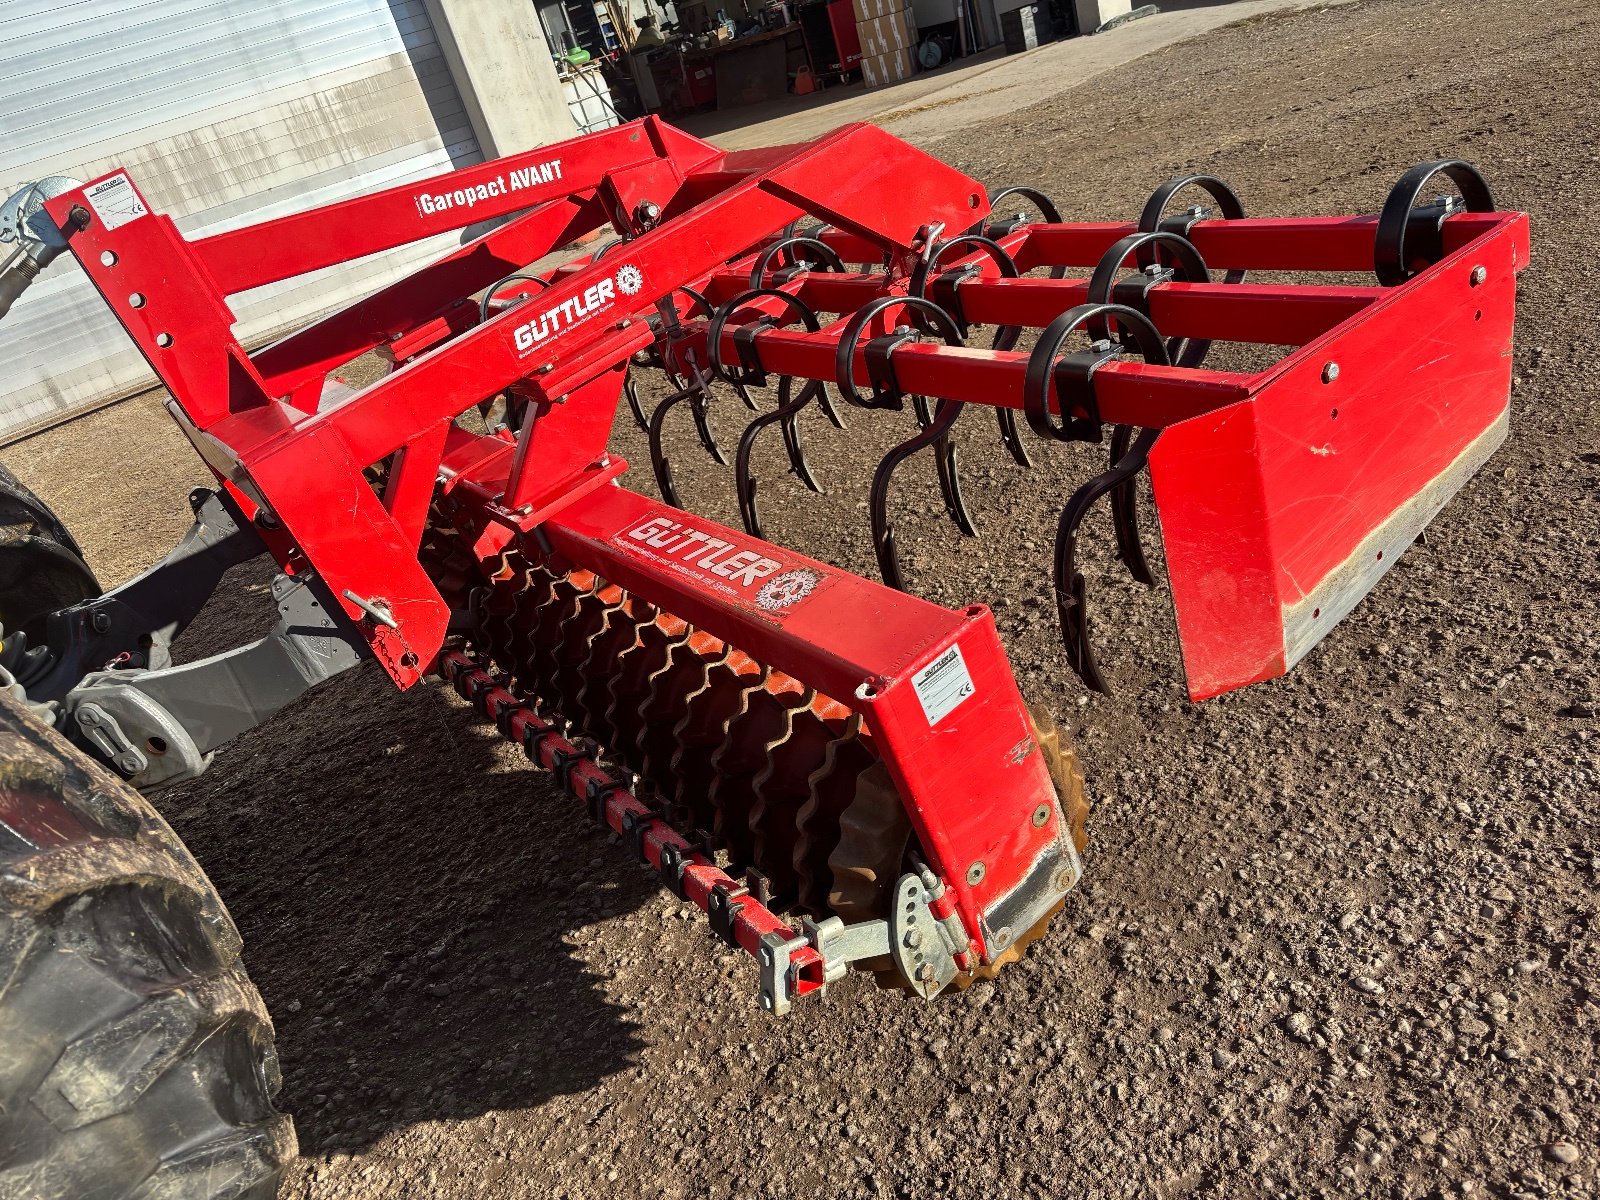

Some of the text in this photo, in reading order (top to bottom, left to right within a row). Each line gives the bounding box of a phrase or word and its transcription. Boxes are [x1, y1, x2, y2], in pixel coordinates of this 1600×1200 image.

[420, 176, 507, 215] Garopact
[510, 159, 562, 191] AVANT
[513, 277, 616, 351] GÜTTLER
[627, 517, 783, 588] GÜTTLER
[712, 581, 739, 596] System
